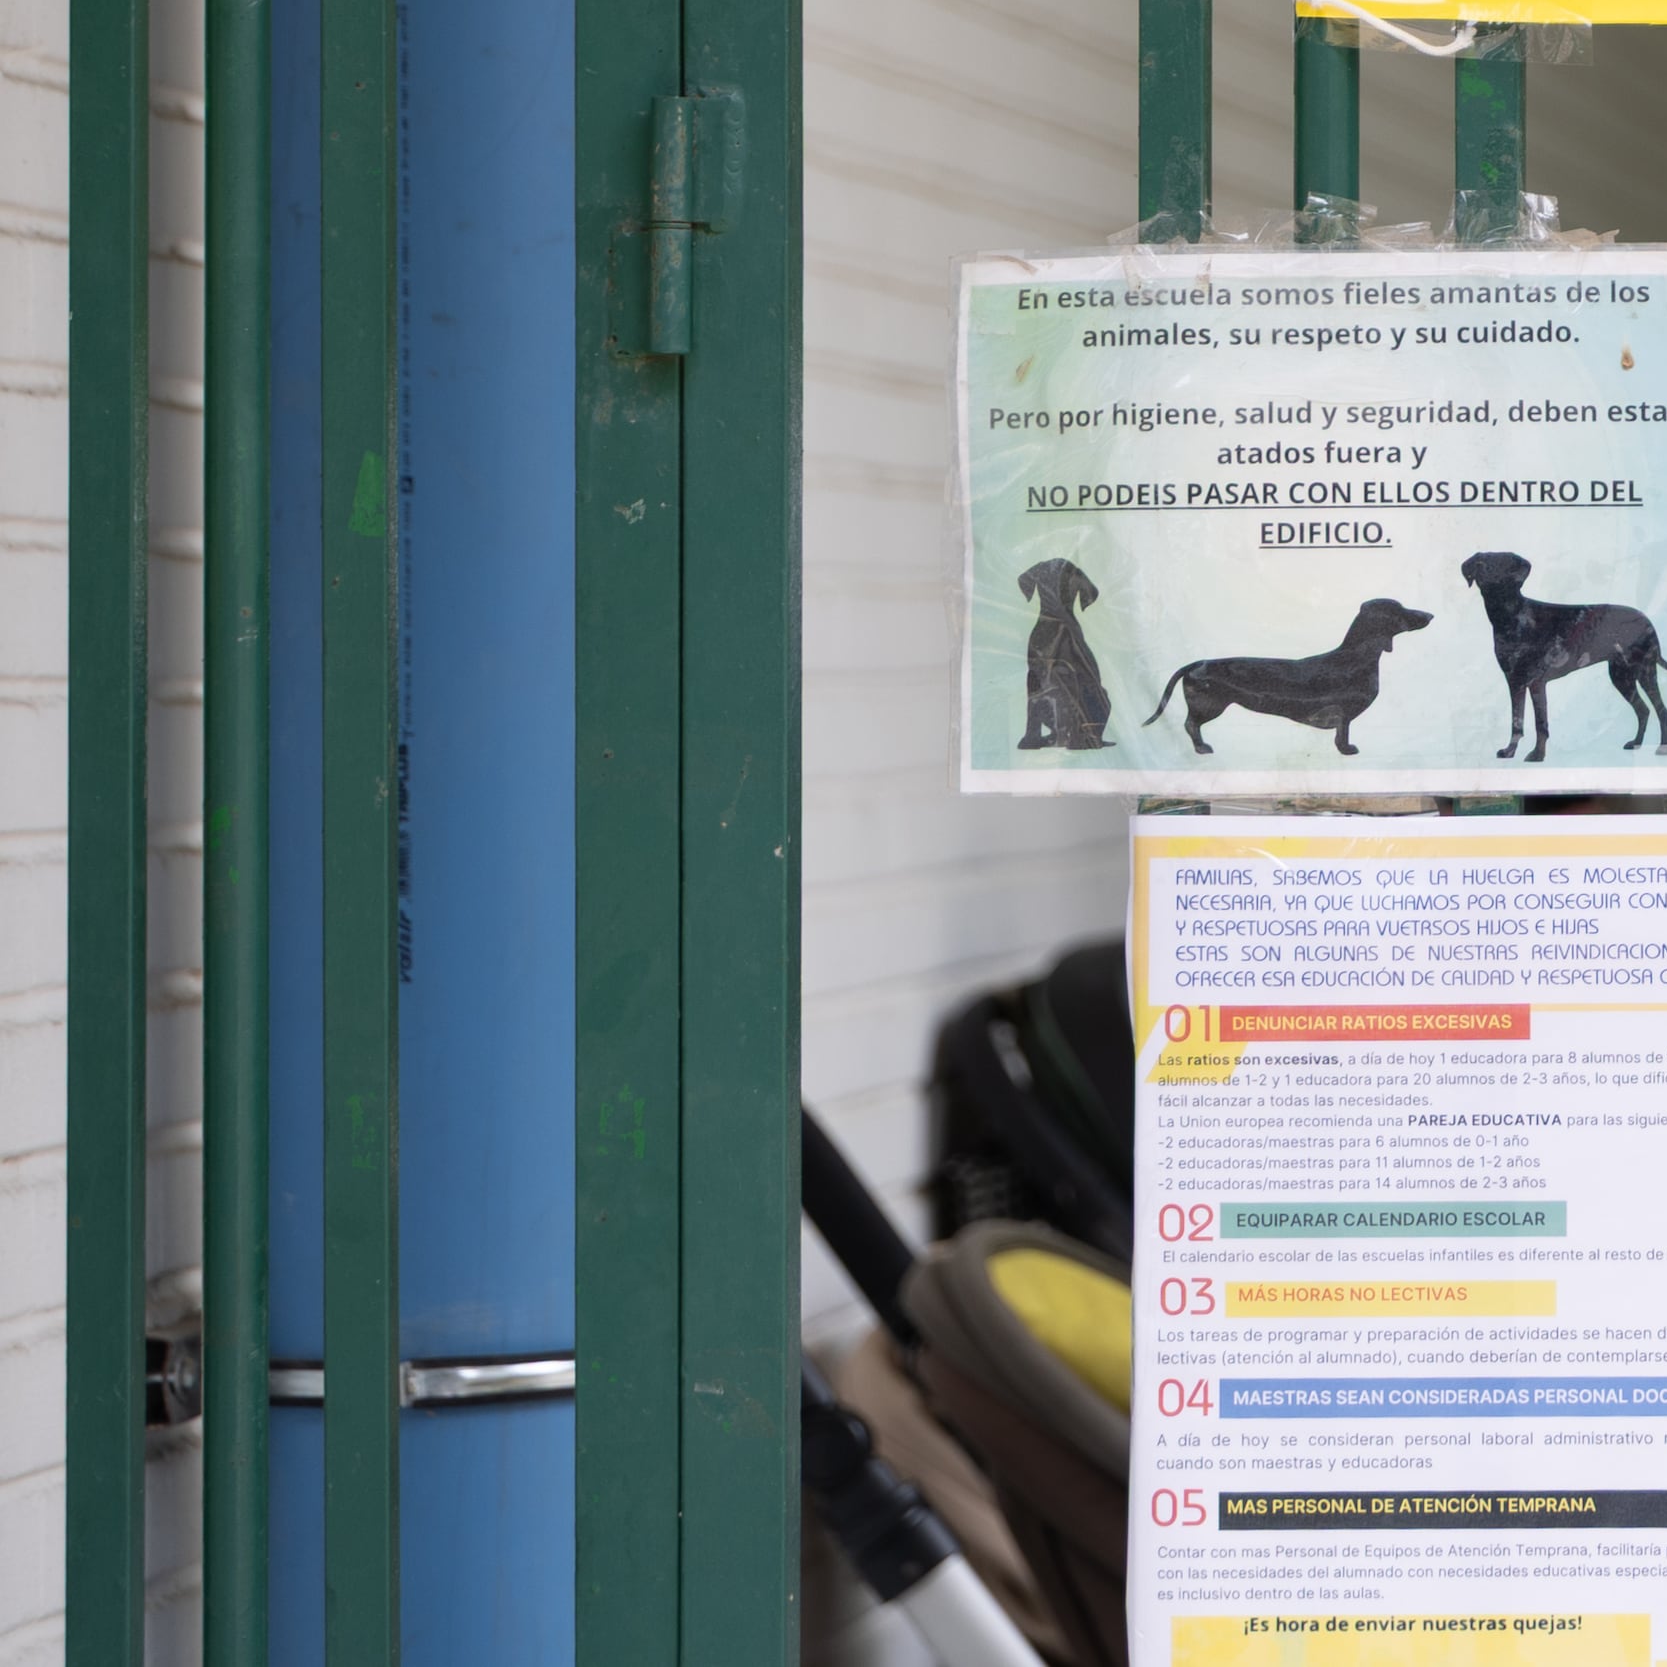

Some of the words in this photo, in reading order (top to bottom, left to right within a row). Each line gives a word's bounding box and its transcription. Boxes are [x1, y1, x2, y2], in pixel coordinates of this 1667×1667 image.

[1017, 288, 1049, 311] En
[1057, 287, 1115, 309] esta
[1123, 282, 1231, 307] escuela
[1241, 287, 1334, 306] somos
[1343, 281, 1421, 305] fieles
[1429, 283, 1557, 305] amantas
[1566, 280, 1601, 304] de
[1610, 279, 1650, 303] los
[1082, 322, 1219, 349] animales,
[1229, 328, 1261, 346] su
[1271, 324, 1382, 352] respeto
[1390, 327, 1407, 351] y
[1415, 326, 1447, 344] su
[1456, 319, 1580, 344] cuidado.
[990, 408, 1051, 429] Pero
[1059, 409, 1104, 435] por
[1112, 402, 1225, 432] higiene,
[1234, 400, 1312, 425] salud
[1321, 406, 1338, 431] y
[1346, 399, 1498, 431] seguridad,
[1508, 399, 1597, 423] deben
[1217, 441, 1315, 465] atados
[1324, 440, 1402, 464] fuera
[1411, 446, 1428, 471] y
[1028, 485, 1069, 508] NO
[1078, 483, 1177, 507] PODEIS
[1187, 482, 1279, 505] PASAR
[1288, 481, 1352, 504] CON
[1363, 480, 1450, 504] ELLOS
[1460, 480, 1580, 503] DENTRO
[1590, 480, 1643, 503] DEL
[1261, 521, 1392, 545] EDIFICIO.
[1175, 868, 1258, 888] FAMILIAS,
[1272, 868, 1362, 886] SABEMOS
[1375, 869, 1415, 889] QUE
[1429, 869, 1449, 886] LA
[1462, 868, 1535, 886] HUELGA
[1548, 867, 1570, 885] ES
[1175, 894, 1277, 913] NECESARIA,
[1284, 894, 1307, 911] YA
[1314, 894, 1353, 914] QUE
[1361, 894, 1461, 911] LUCHAMOS
[1467, 893, 1507, 911] POR
[1513, 892, 1621, 911] CONSEGUIR
[1175, 919, 1187, 937] Y
[1192, 919, 1318, 937] RESPETUOSAS
[1323, 919, 1370, 937] PARA
[1375, 919, 1471, 937] VUETRSOS
[1476, 918, 1529, 936] HIJOS
[1534, 918, 1545, 935] E
[1552, 918, 1600, 935] HIJAS
[1175, 945, 1229, 962] ESTAS
[1240, 944, 1282, 962] SON
[1294, 945, 1379, 962] ALGUNAS
[1391, 945, 1415, 962] DE
[1427, 944, 1519, 962] NUESTRAS
[1175, 970, 1256, 988] OFRECER
[1261, 970, 1296, 988] ESA
[1300, 966, 1405, 988] EDUCACIÓN
[1411, 970, 1435, 987] DE
[1441, 969, 1515, 986] CALIDAD
[1520, 969, 1532, 986] Y
[1537, 968, 1654, 986] RESPETUOSA
[1164, 1003, 1211, 1043] 01
[1232, 1015, 1338, 1032] DENUNCIAR
[1341, 1014, 1408, 1031] RATIOS
[1411, 1013, 1513, 1030] EXCESIVAS
[1158, 1203, 1214, 1242] 02
[1236, 1211, 1339, 1229] EQUIPARAR
[1342, 1211, 1458, 1228] CALENDARIO
[1462, 1211, 1546, 1230] ESCOLAR
[1160, 1277, 1216, 1316] 03
[1237, 1283, 1279, 1303] MÁS
[1282, 1286, 1345, 1303] HORAS
[1349, 1286, 1376, 1302] NO
[1380, 1286, 1468, 1302] LECTIVAS
[1158, 1378, 1214, 1417] 04
[1233, 1389, 1332, 1406] MAESTRAS
[1335, 1389, 1385, 1406] SEAN
[1388, 1388, 1530, 1405] CONSIDERADAS
[1533, 1388, 1629, 1405] PERSONAL
[1151, 1488, 1206, 1527] 05
[1227, 1498, 1268, 1515] MAS
[1271, 1498, 1367, 1515] PERSONAL
[1371, 1498, 1395, 1514] DE
[1398, 1494, 1492, 1514] ATENCIÓN
[1495, 1496, 1597, 1514] TEMPRANA
[1244, 1617, 1270, 1636] ¡Es
[1275, 1616, 1320, 1633] hora
[1325, 1615, 1349, 1632] de
[1354, 1615, 1417, 1632] enviar
[1422, 1617, 1507, 1632] nuestras
[1512, 1614, 1582, 1635] quejas!
